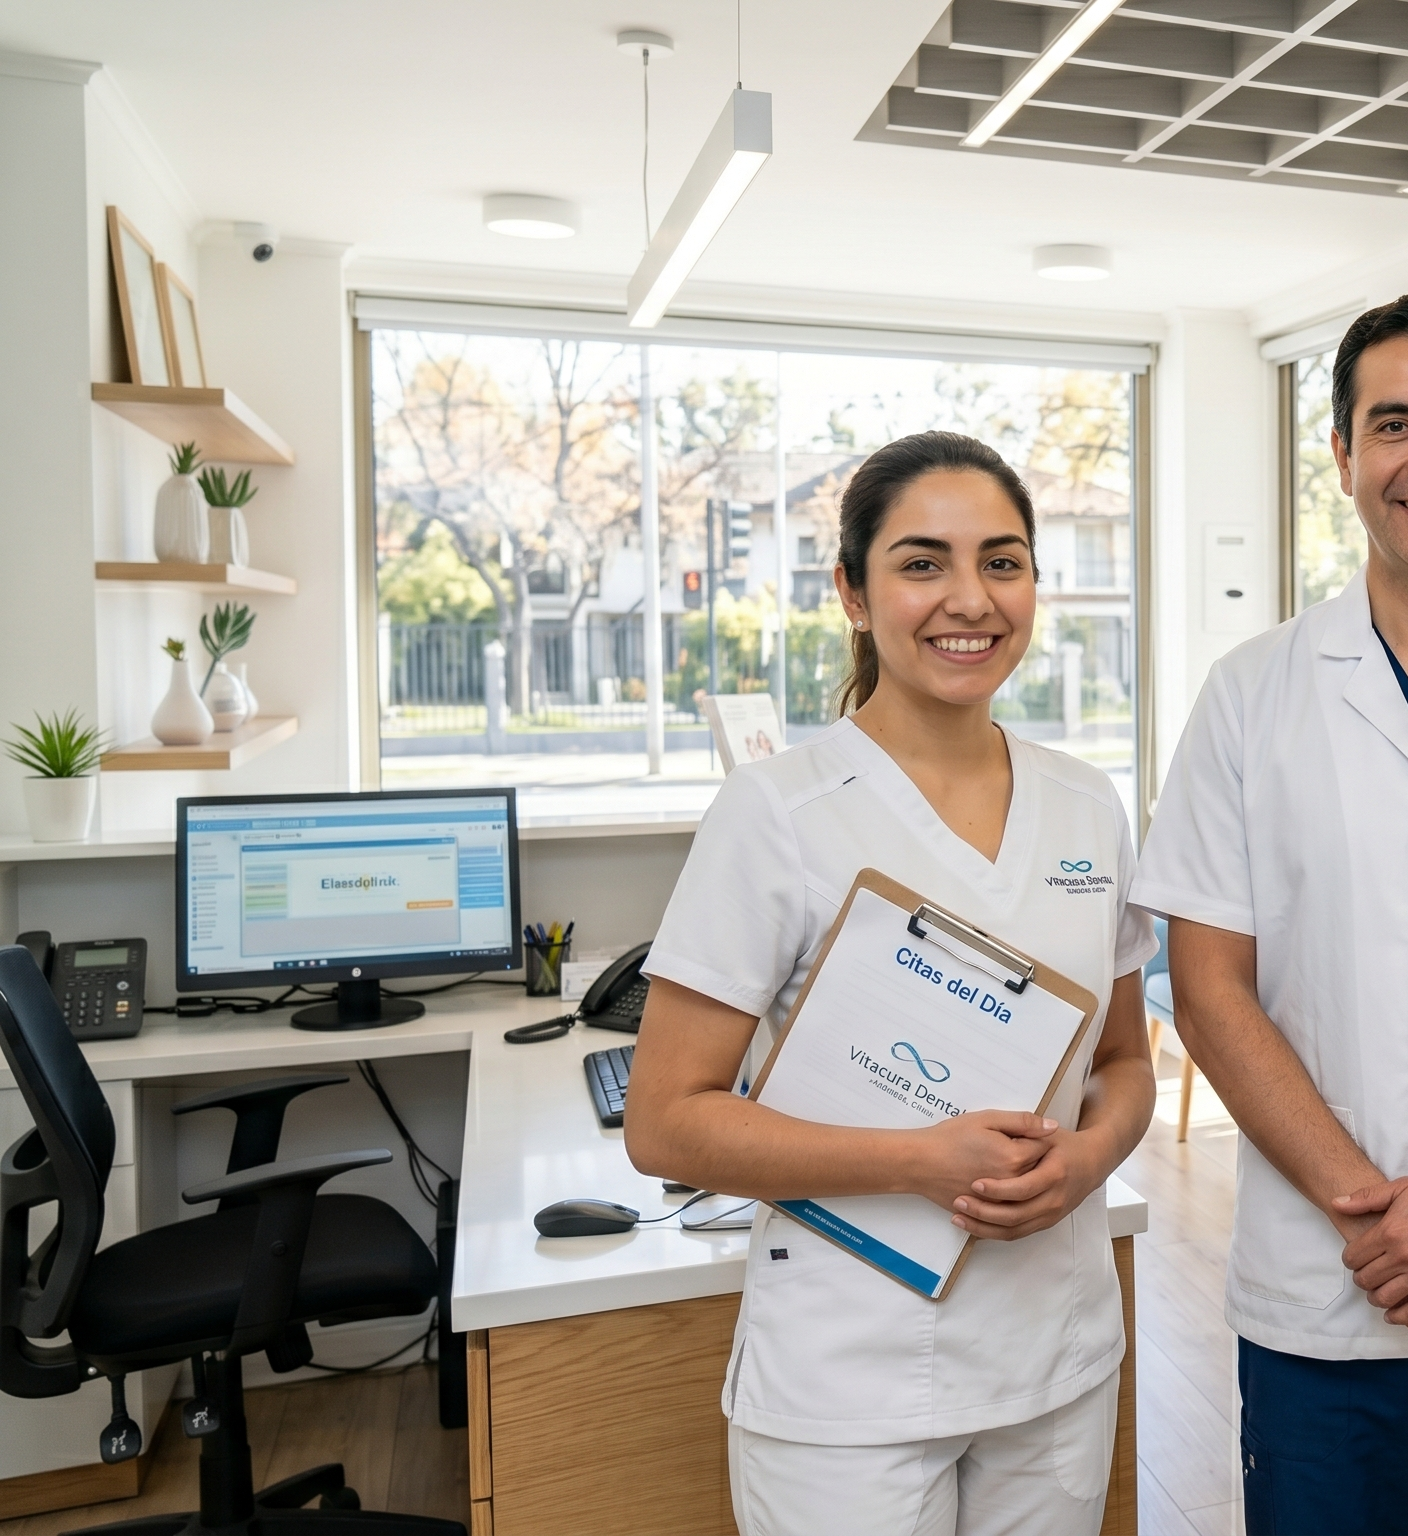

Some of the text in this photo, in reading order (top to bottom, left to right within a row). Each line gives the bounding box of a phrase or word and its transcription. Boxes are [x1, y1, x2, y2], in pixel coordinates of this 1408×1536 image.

[896, 947, 1012, 1024] Citas del Día
[850, 1045, 912, 1091] Vitacura
